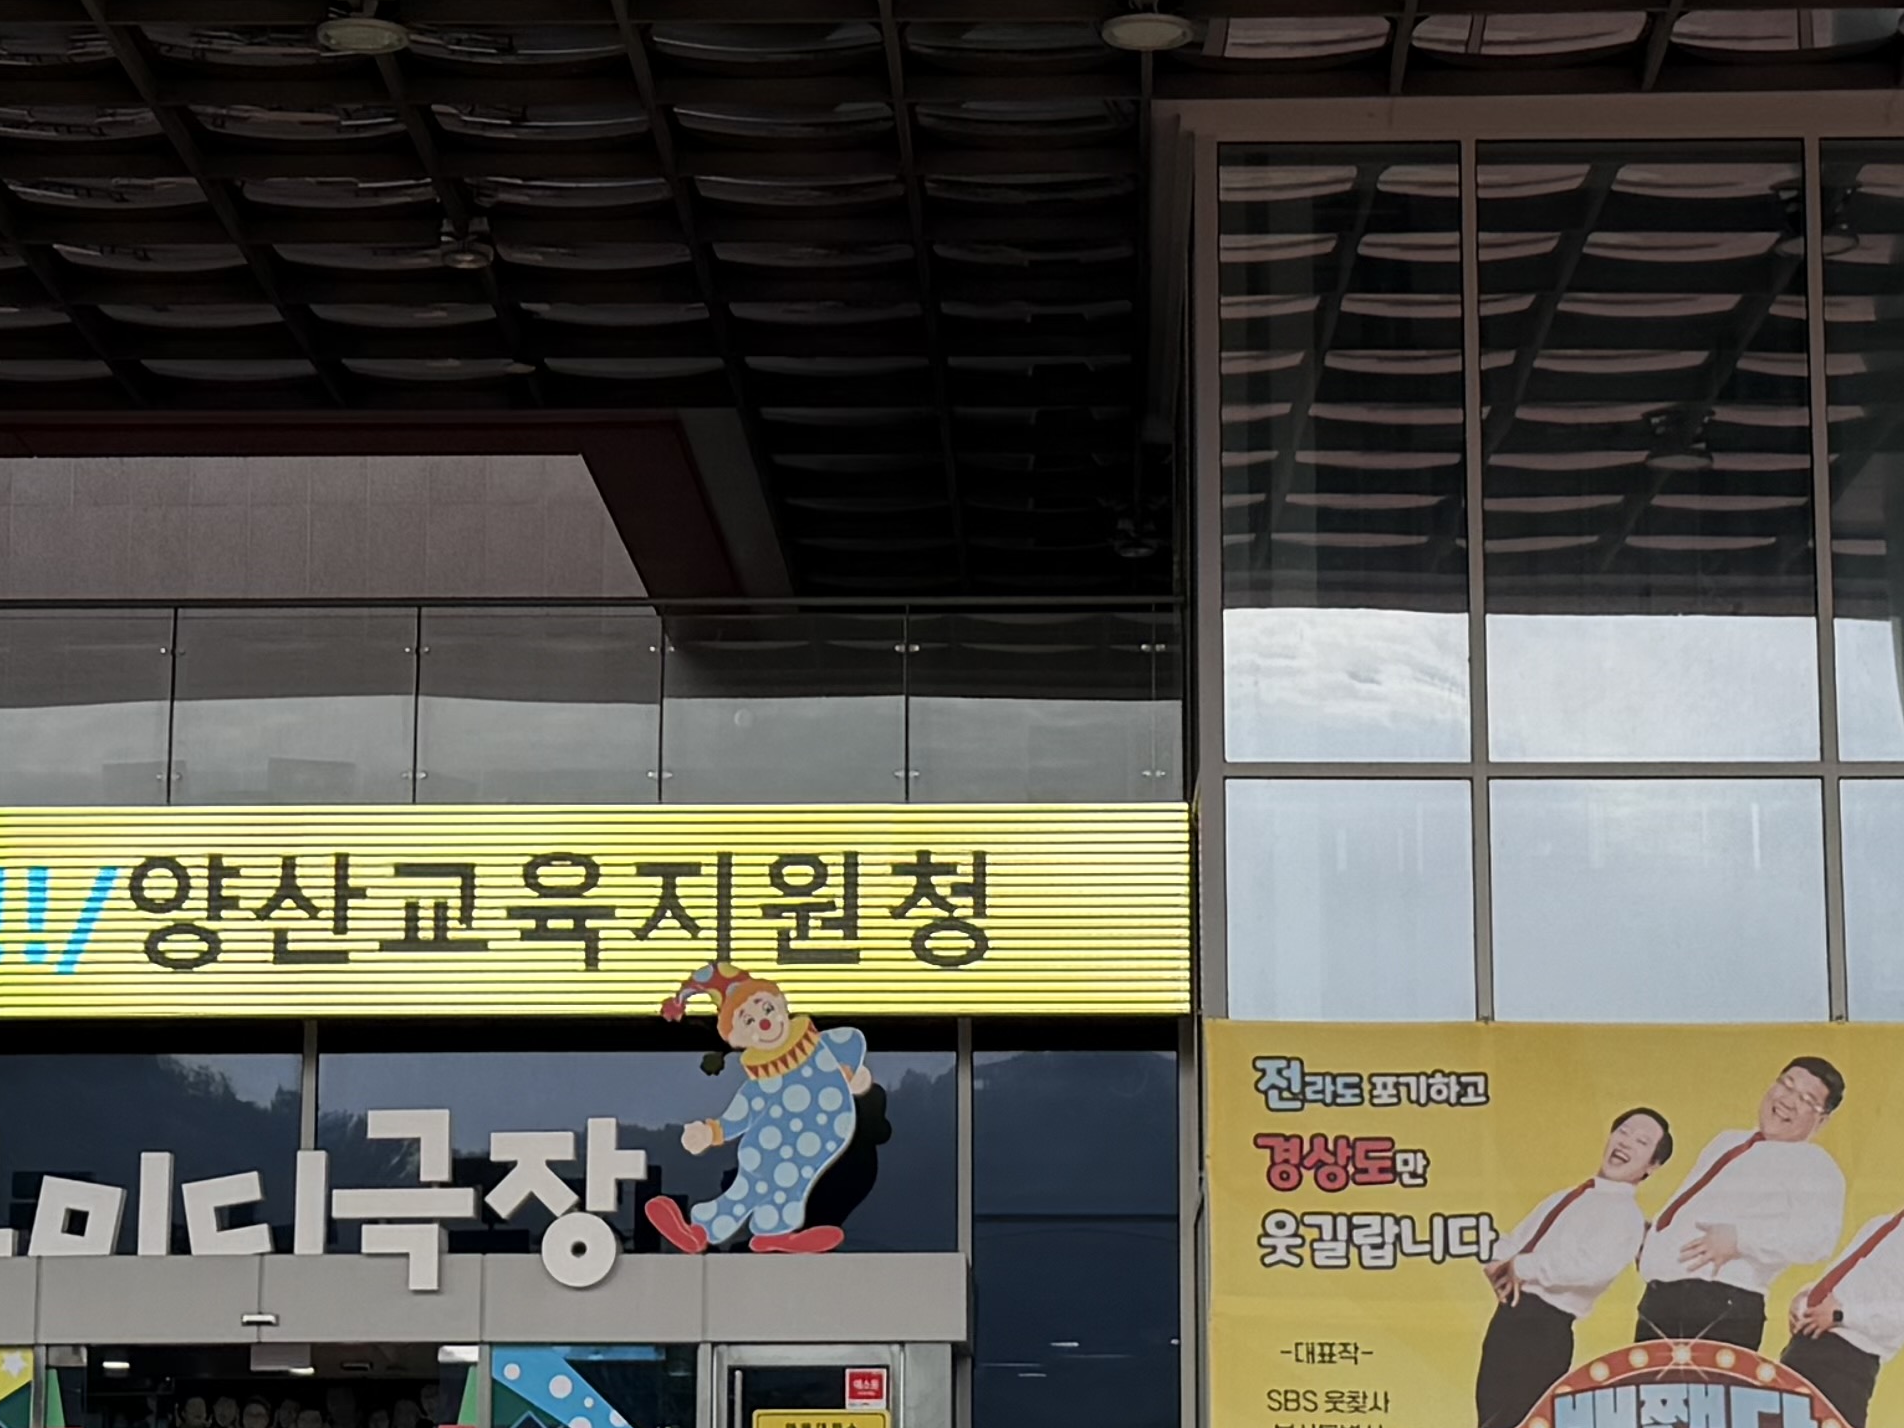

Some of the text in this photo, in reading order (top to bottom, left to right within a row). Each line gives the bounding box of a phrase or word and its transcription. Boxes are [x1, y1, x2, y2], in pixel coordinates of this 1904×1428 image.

[1252, 1055, 1489, 1112] 전라도 포기하고
[1254, 1133, 1430, 1193] 경상도만
[1257, 1209, 1499, 1270] 웃길랍니다
[1266, 1389, 1390, 1414] SBS 웃찾사
